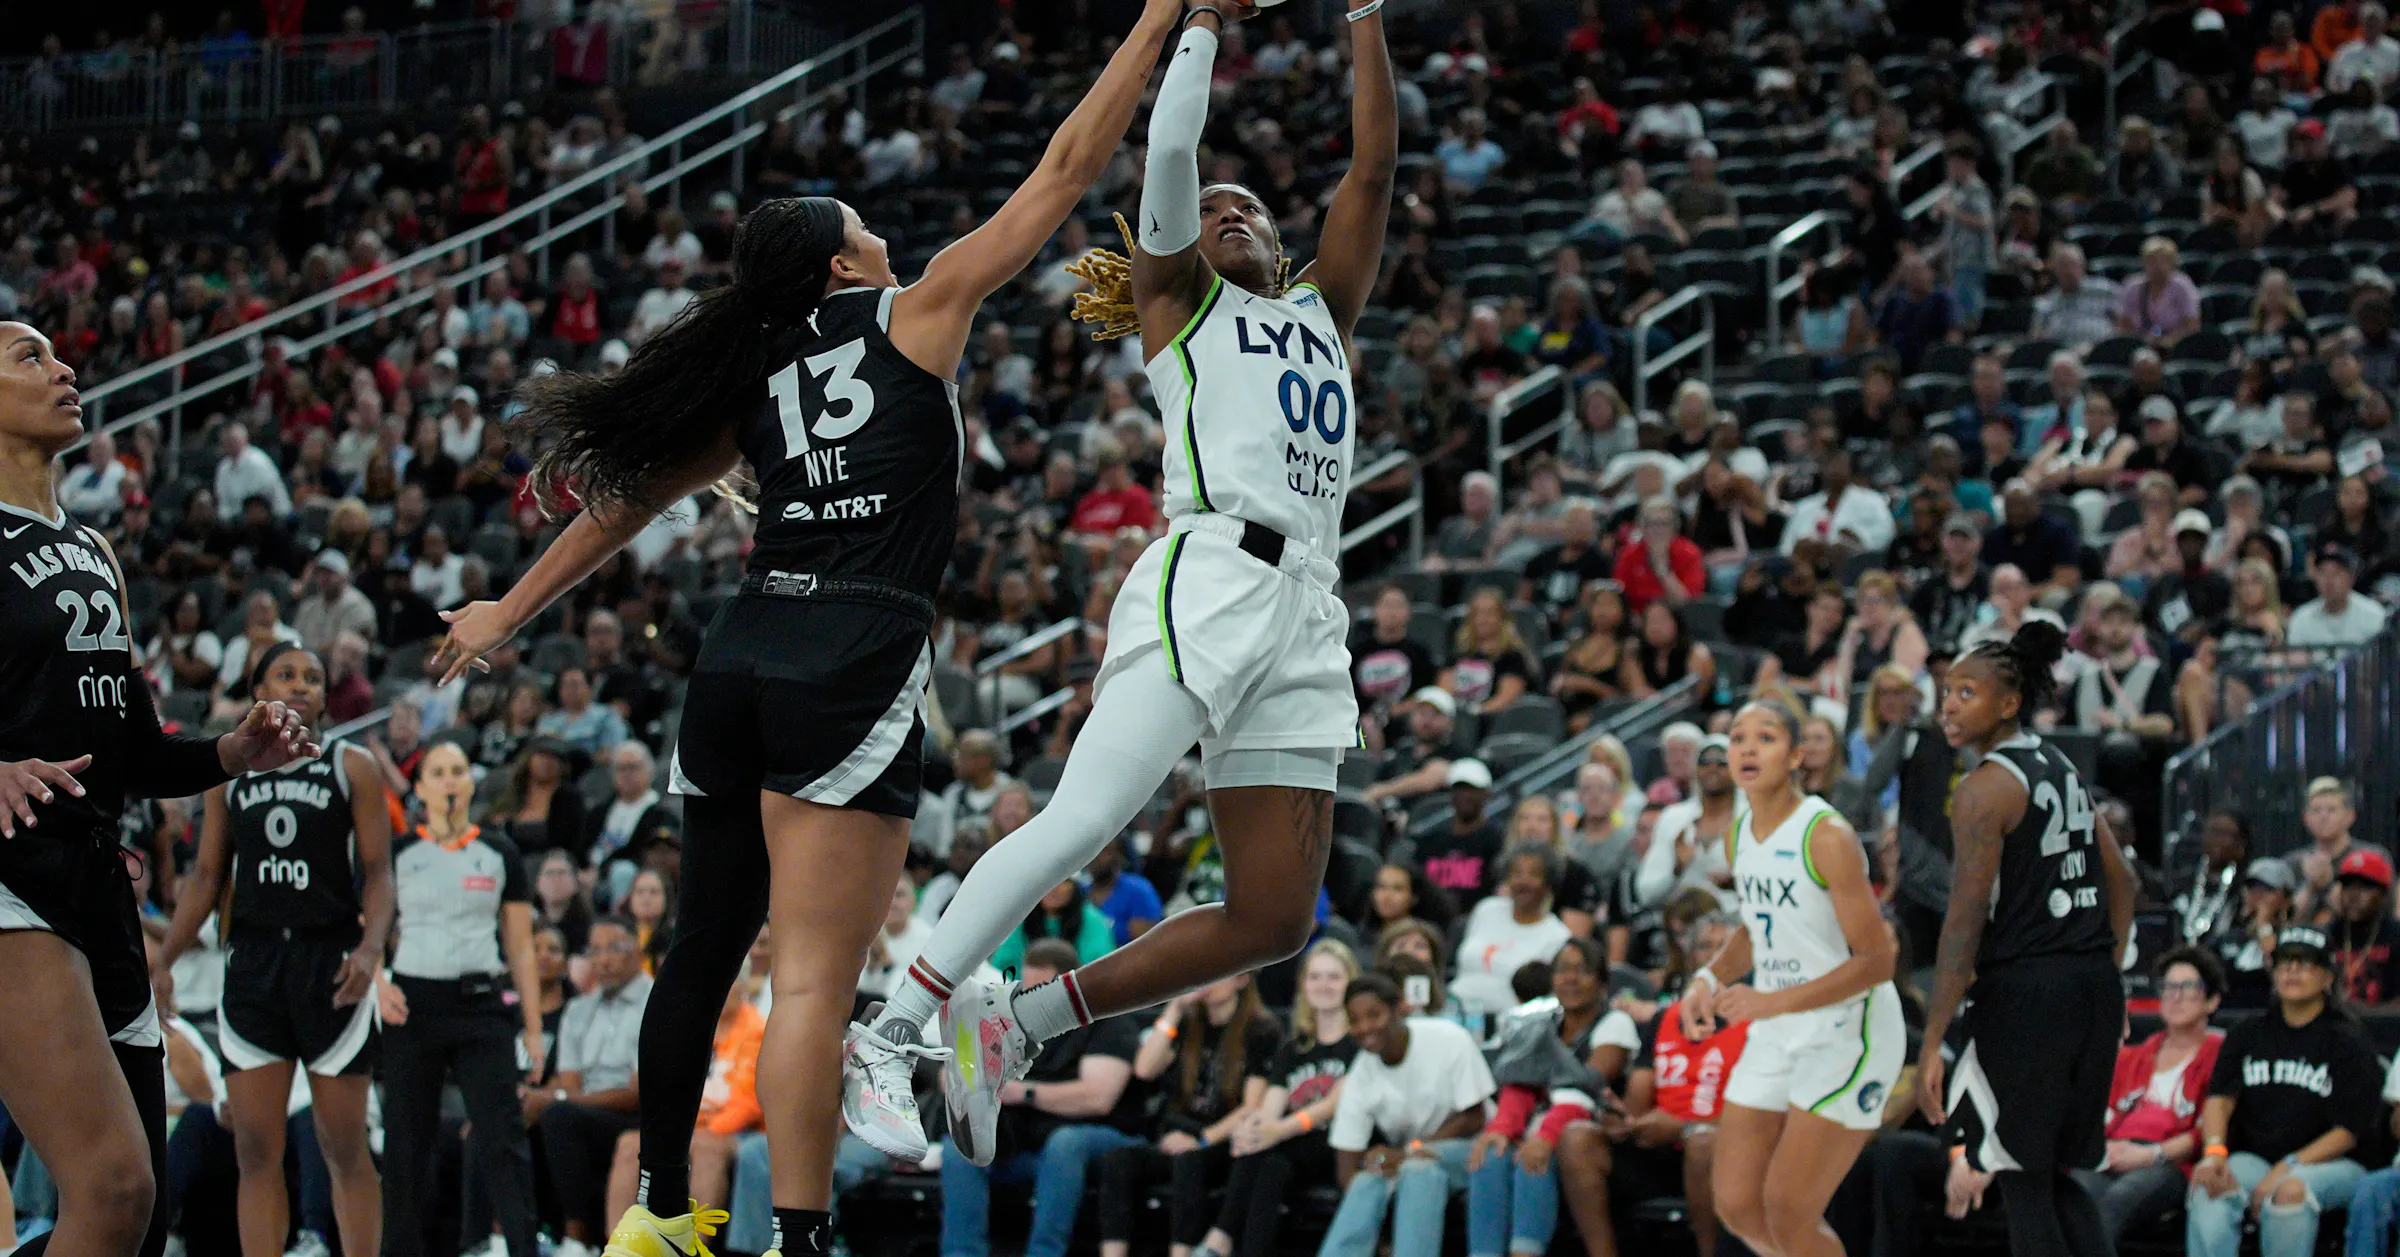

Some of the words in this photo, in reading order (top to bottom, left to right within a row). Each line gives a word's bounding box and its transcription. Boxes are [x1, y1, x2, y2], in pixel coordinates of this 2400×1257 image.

[768, 336, 875, 460] 13
[1278, 369, 1347, 445] 00
[804, 446, 849, 488] NYE
[822, 493, 888, 520] AT&T
[9, 545, 64, 590] LAS
[55, 589, 129, 652] 22
[237, 780, 274, 812] LAS
[273, 780, 332, 811] VEGAS
[2033, 771, 2096, 858] 24
[264, 804, 298, 849] 0
[258, 852, 310, 892] ring
[1740, 874, 1799, 909] YNX
[1756, 911, 1773, 950] 7
